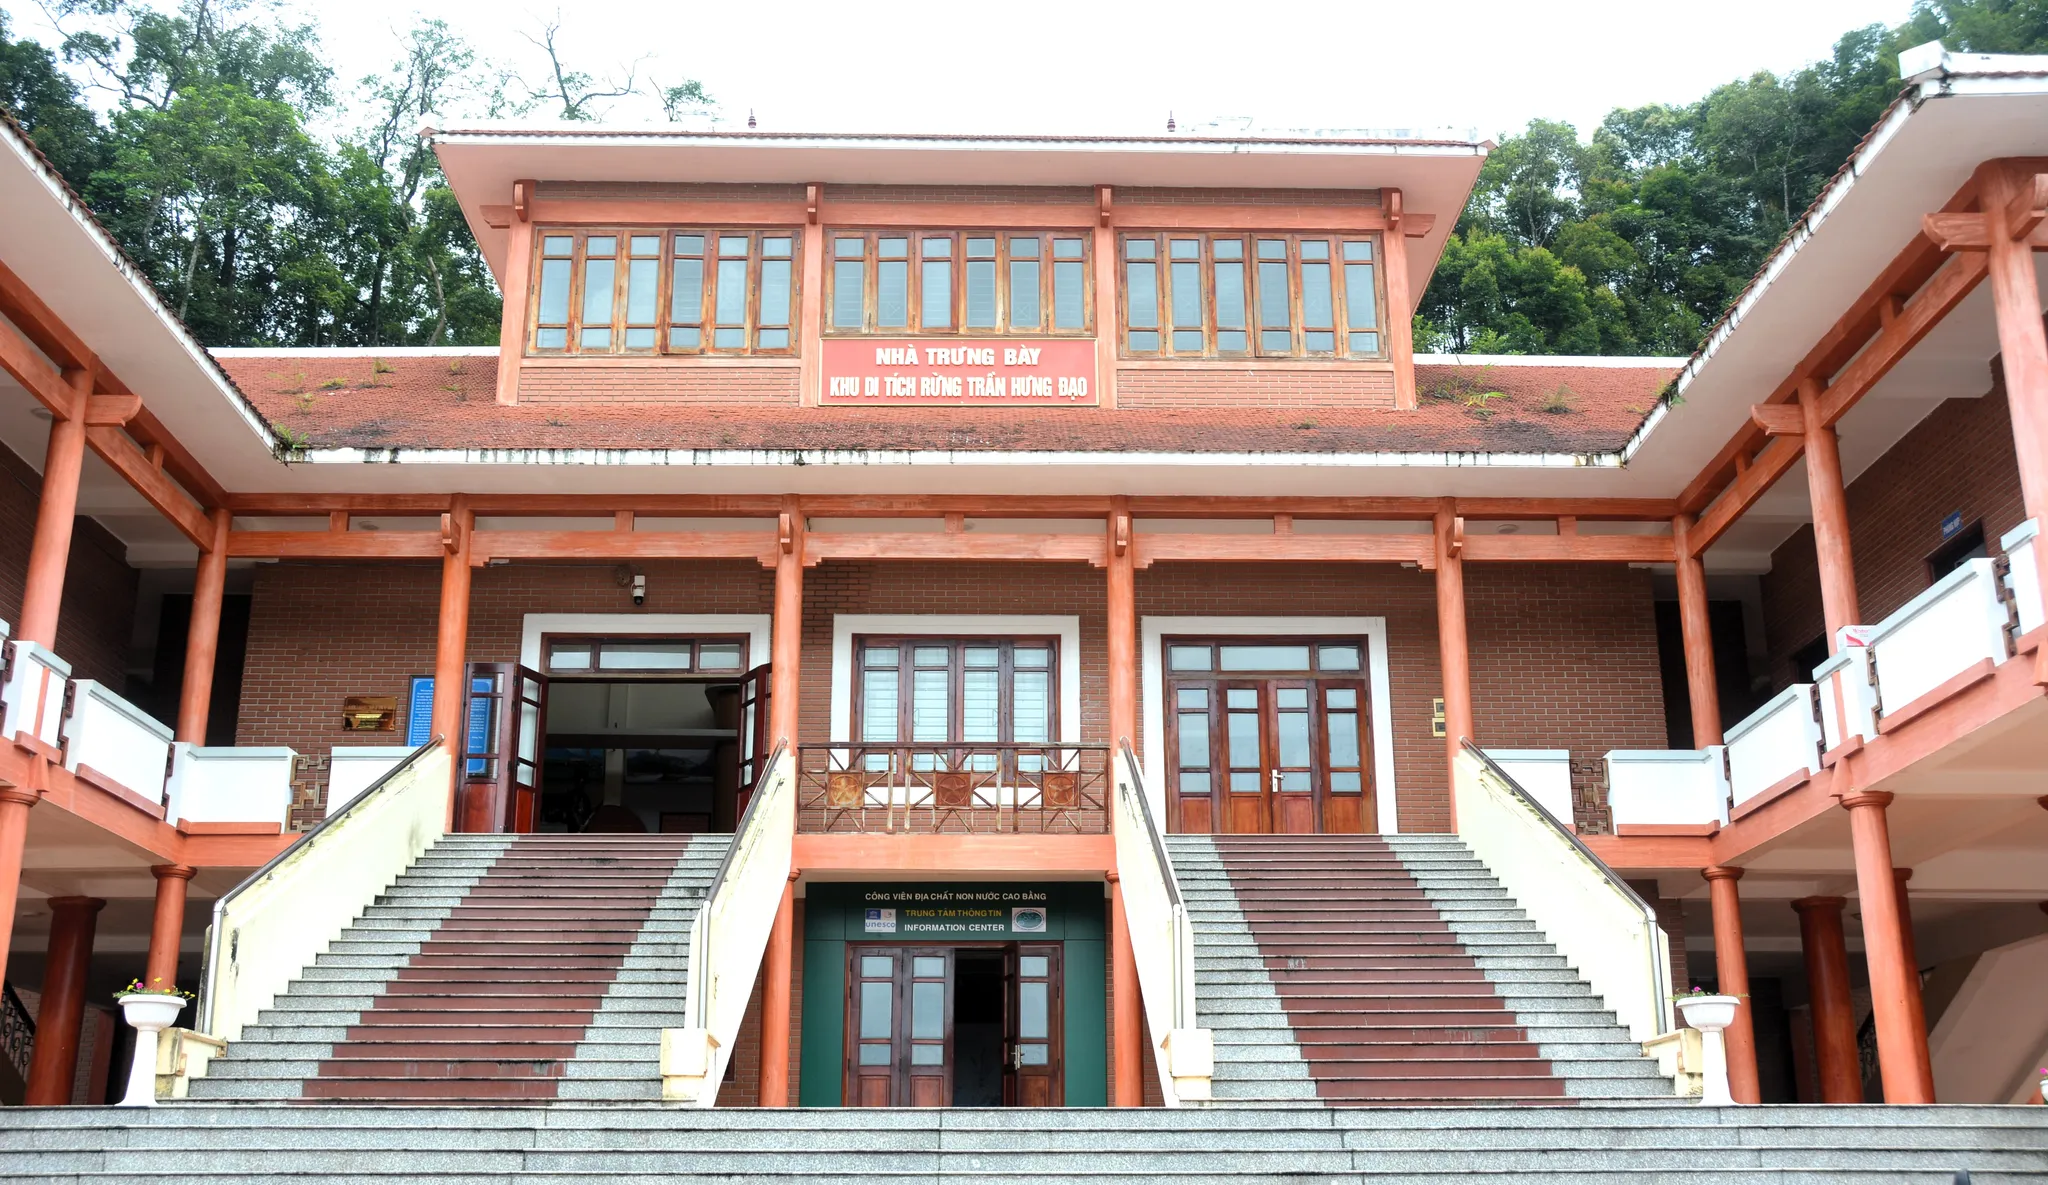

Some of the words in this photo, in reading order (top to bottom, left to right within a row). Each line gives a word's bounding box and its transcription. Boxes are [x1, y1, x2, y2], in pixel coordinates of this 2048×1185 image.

[876, 344, 919, 365] NHÀ
[925, 346, 995, 365] TRƯNG
[1004, 344, 1042, 365] BÀY
[830, 376, 860, 397] KHU
[864, 376, 879, 397] DI
[884, 372, 916, 397] TÍCH
[920, 372, 962, 397] RỪNG
[967, 371, 1006, 397] TRẦN
[1010, 375, 1052, 397] HƯNG
[1058, 377, 1088, 400] ĐẠO
[865, 891, 890, 900] CÔNG
[893, 891, 912, 900] VIÊN
[915, 893, 929, 901] ĐỊA
[930, 890, 954, 900] CHẤT
[976, 891, 1000, 900] NƯỚC
[905, 909, 935, 917] TRUNG
[937, 908, 956, 917] TÂM
[957, 908, 987, 917] THÔNG
[988, 909, 1002, 917] TIN
